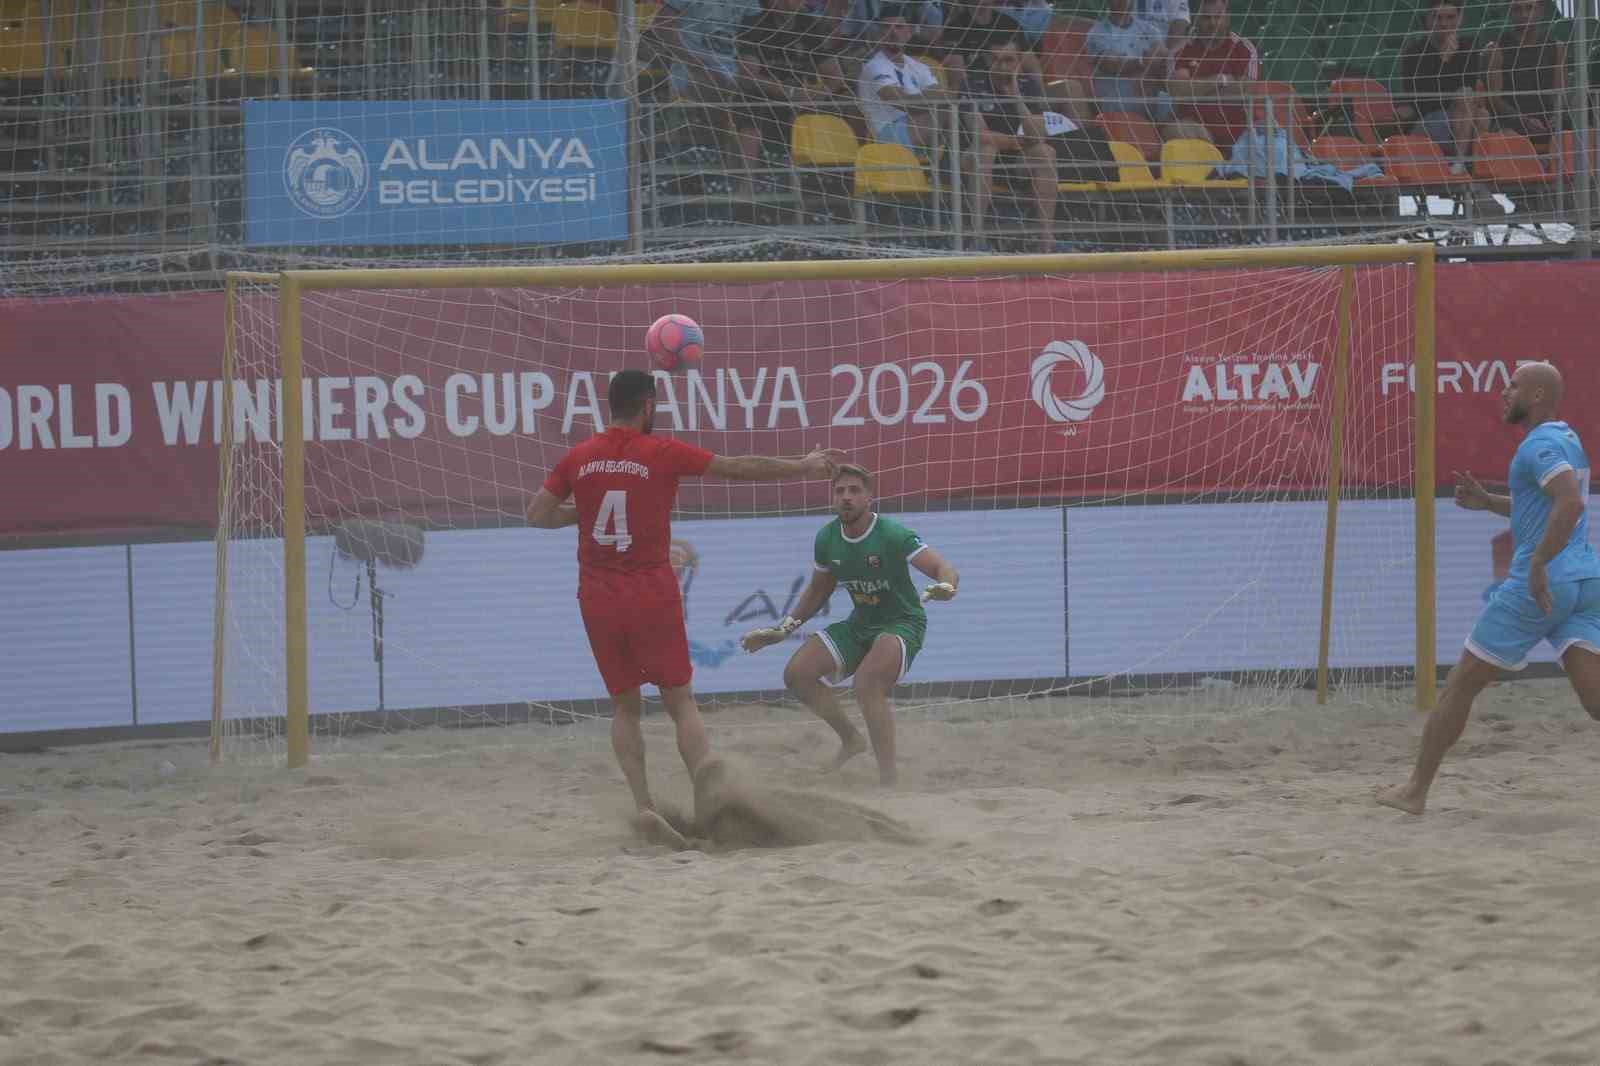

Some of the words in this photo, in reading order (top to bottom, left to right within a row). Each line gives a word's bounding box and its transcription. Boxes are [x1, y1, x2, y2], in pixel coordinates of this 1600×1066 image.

[380, 138, 595, 171] ALANYA
[379, 173, 596, 205] BELEDİYESİ
[445, 371, 554, 436] CUP
[561, 366, 808, 434] AANYA
[830, 360, 989, 426] 2026
[1182, 362, 1321, 402] ALTAV
[591, 490, 632, 552] 4
